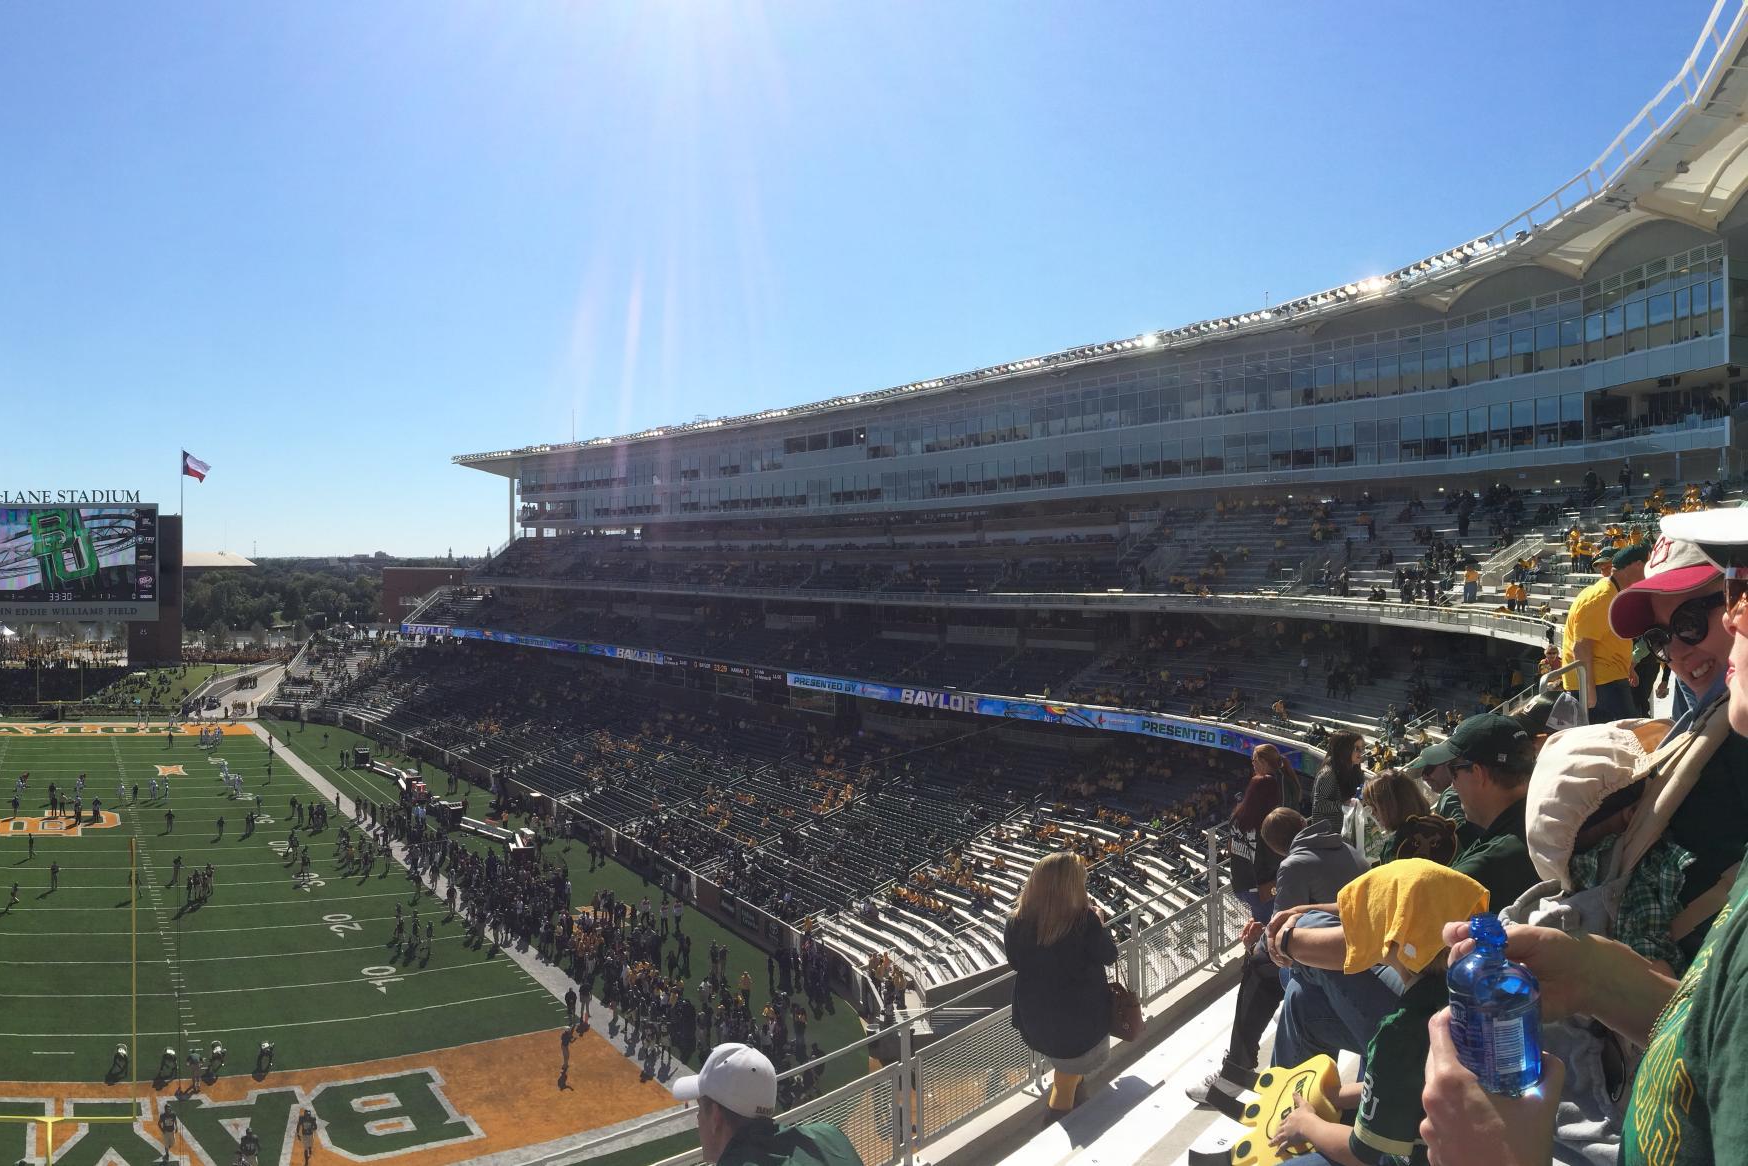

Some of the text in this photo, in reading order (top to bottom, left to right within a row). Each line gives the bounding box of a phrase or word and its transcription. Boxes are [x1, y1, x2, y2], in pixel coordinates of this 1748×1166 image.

[57, 489, 140, 503] STADIUM
[49, 592, 72, 600] 33:30
[15, 608, 47, 617] EDDIE
[52, 608, 103, 616] WILLIAMS
[107, 607, 138, 616] FIELD
[616, 648, 661, 663] BAYLOR
[745, 668, 750, 676] 0
[793, 676, 842, 692] PRESENTED
[845, 683, 857, 694] BY
[900, 688, 978, 713] BAYLOR
[1141, 720, 1216, 744] PRESENTED
[322, 913, 363, 933] 20
[361, 966, 405, 986] 10
